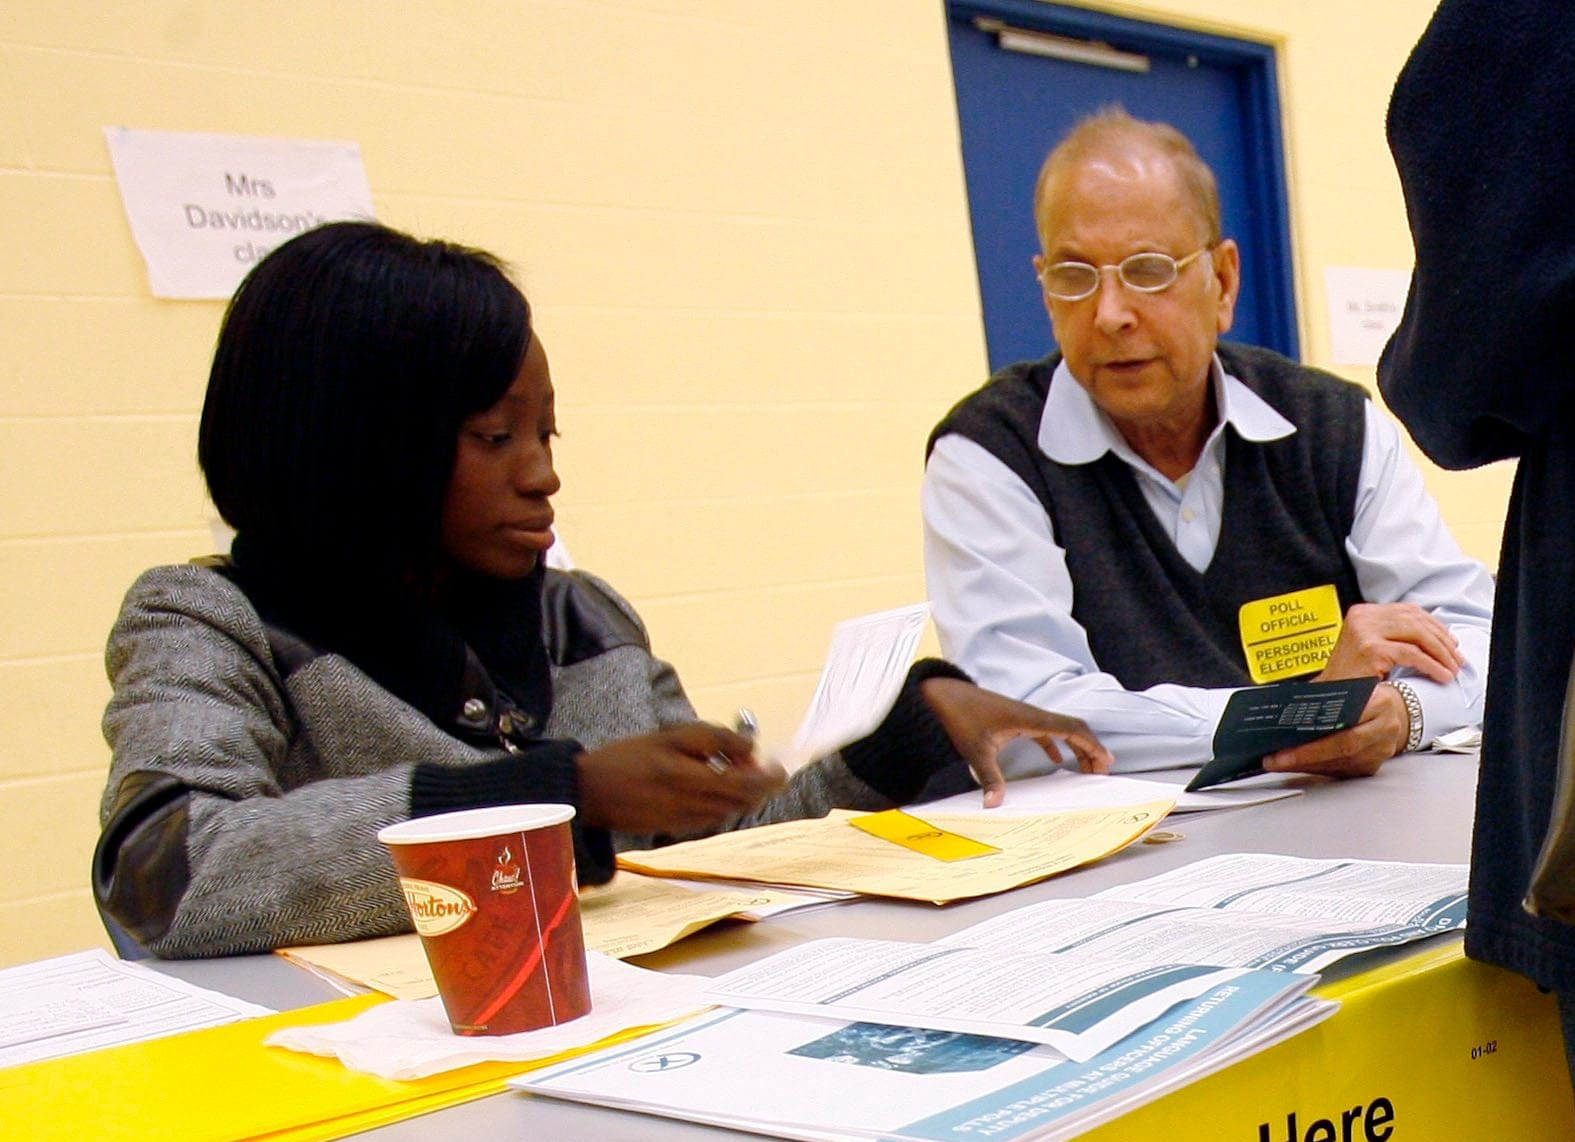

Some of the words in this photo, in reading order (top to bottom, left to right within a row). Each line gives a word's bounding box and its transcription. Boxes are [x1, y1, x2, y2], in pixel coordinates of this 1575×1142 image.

[225, 172, 276, 199] Mrs
[1269, 598, 1304, 616] POLL
[1260, 611, 1319, 633] OFFICIAL
[1256, 634, 1335, 661] PERSONNEL
[1260, 650, 1333, 675] ELECTORA
[1165, 985, 1241, 1035] RETURNING
[1099, 1033, 1171, 1072] OFFICERS
[1124, 1028, 1208, 1073] LANGUAGE
[1471, 1040, 1497, 1060] 01-02
